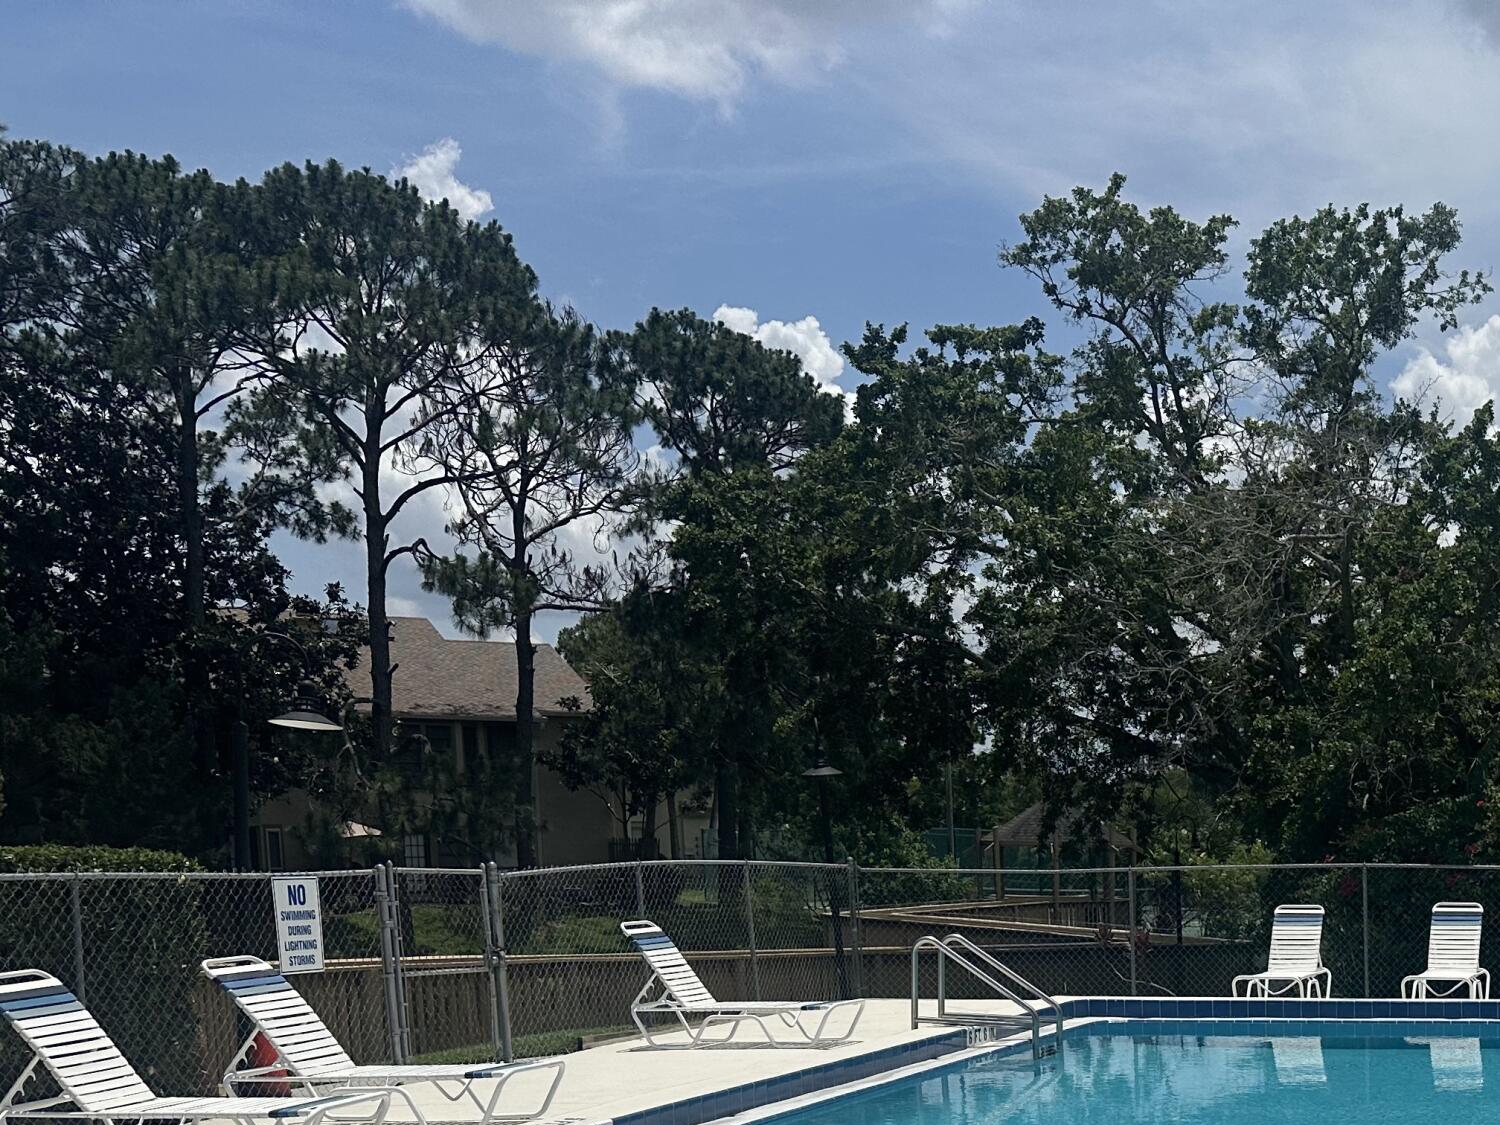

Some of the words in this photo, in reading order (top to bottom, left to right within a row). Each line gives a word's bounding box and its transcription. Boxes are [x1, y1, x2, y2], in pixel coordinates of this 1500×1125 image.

[287, 884, 307, 906] NO
[280, 910, 316, 921] SWIMMING
[288, 925, 312, 936] DURING
[284, 939, 318, 952] LIGHTNING
[289, 954, 316, 967] STORMS
